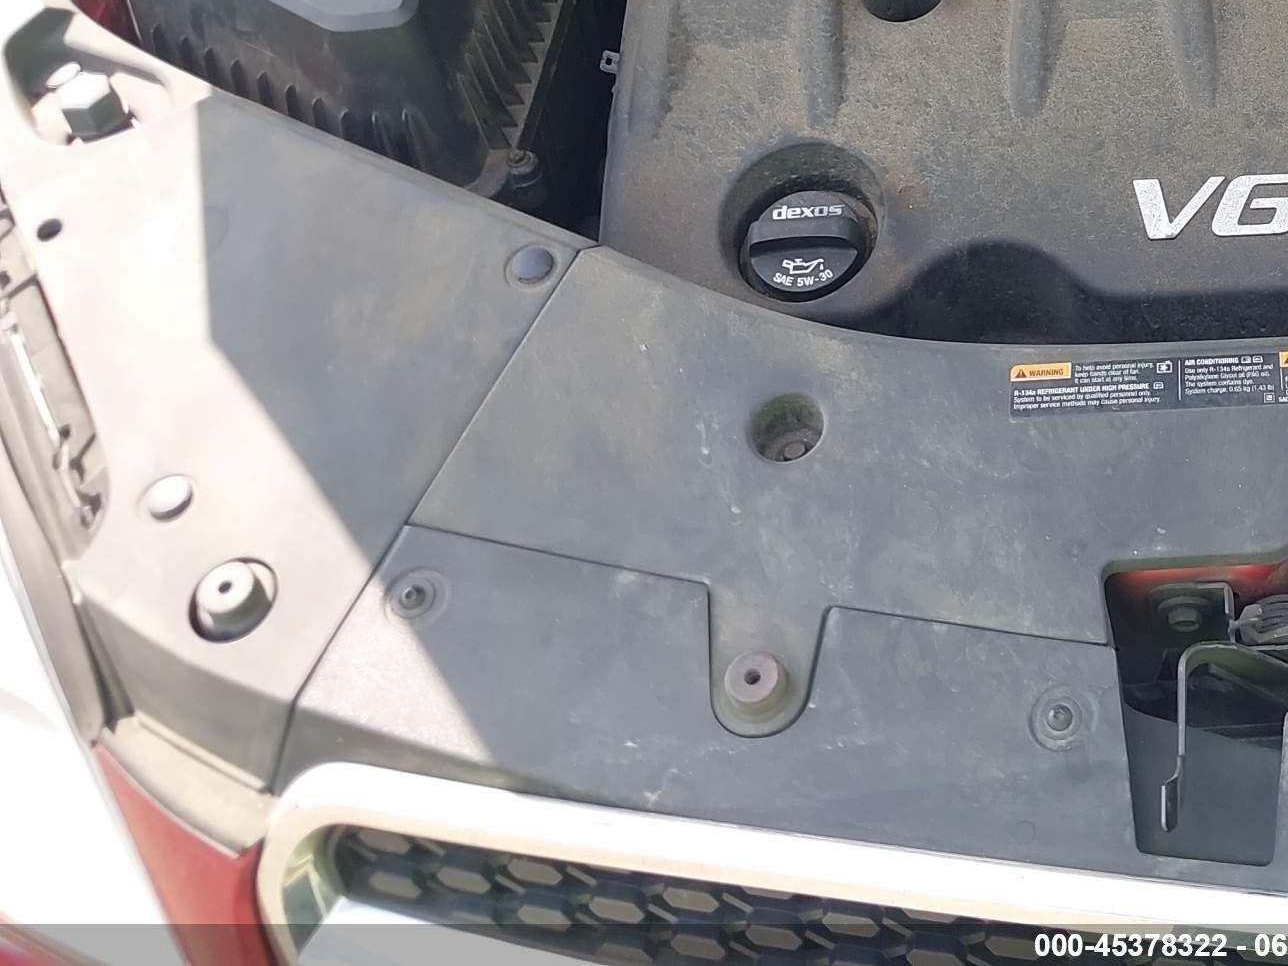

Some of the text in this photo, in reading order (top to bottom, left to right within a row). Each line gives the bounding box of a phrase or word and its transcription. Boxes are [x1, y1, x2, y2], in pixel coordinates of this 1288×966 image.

[772, 204, 844, 220] dexos
[773, 269, 833, 287] SAE 5W-30
